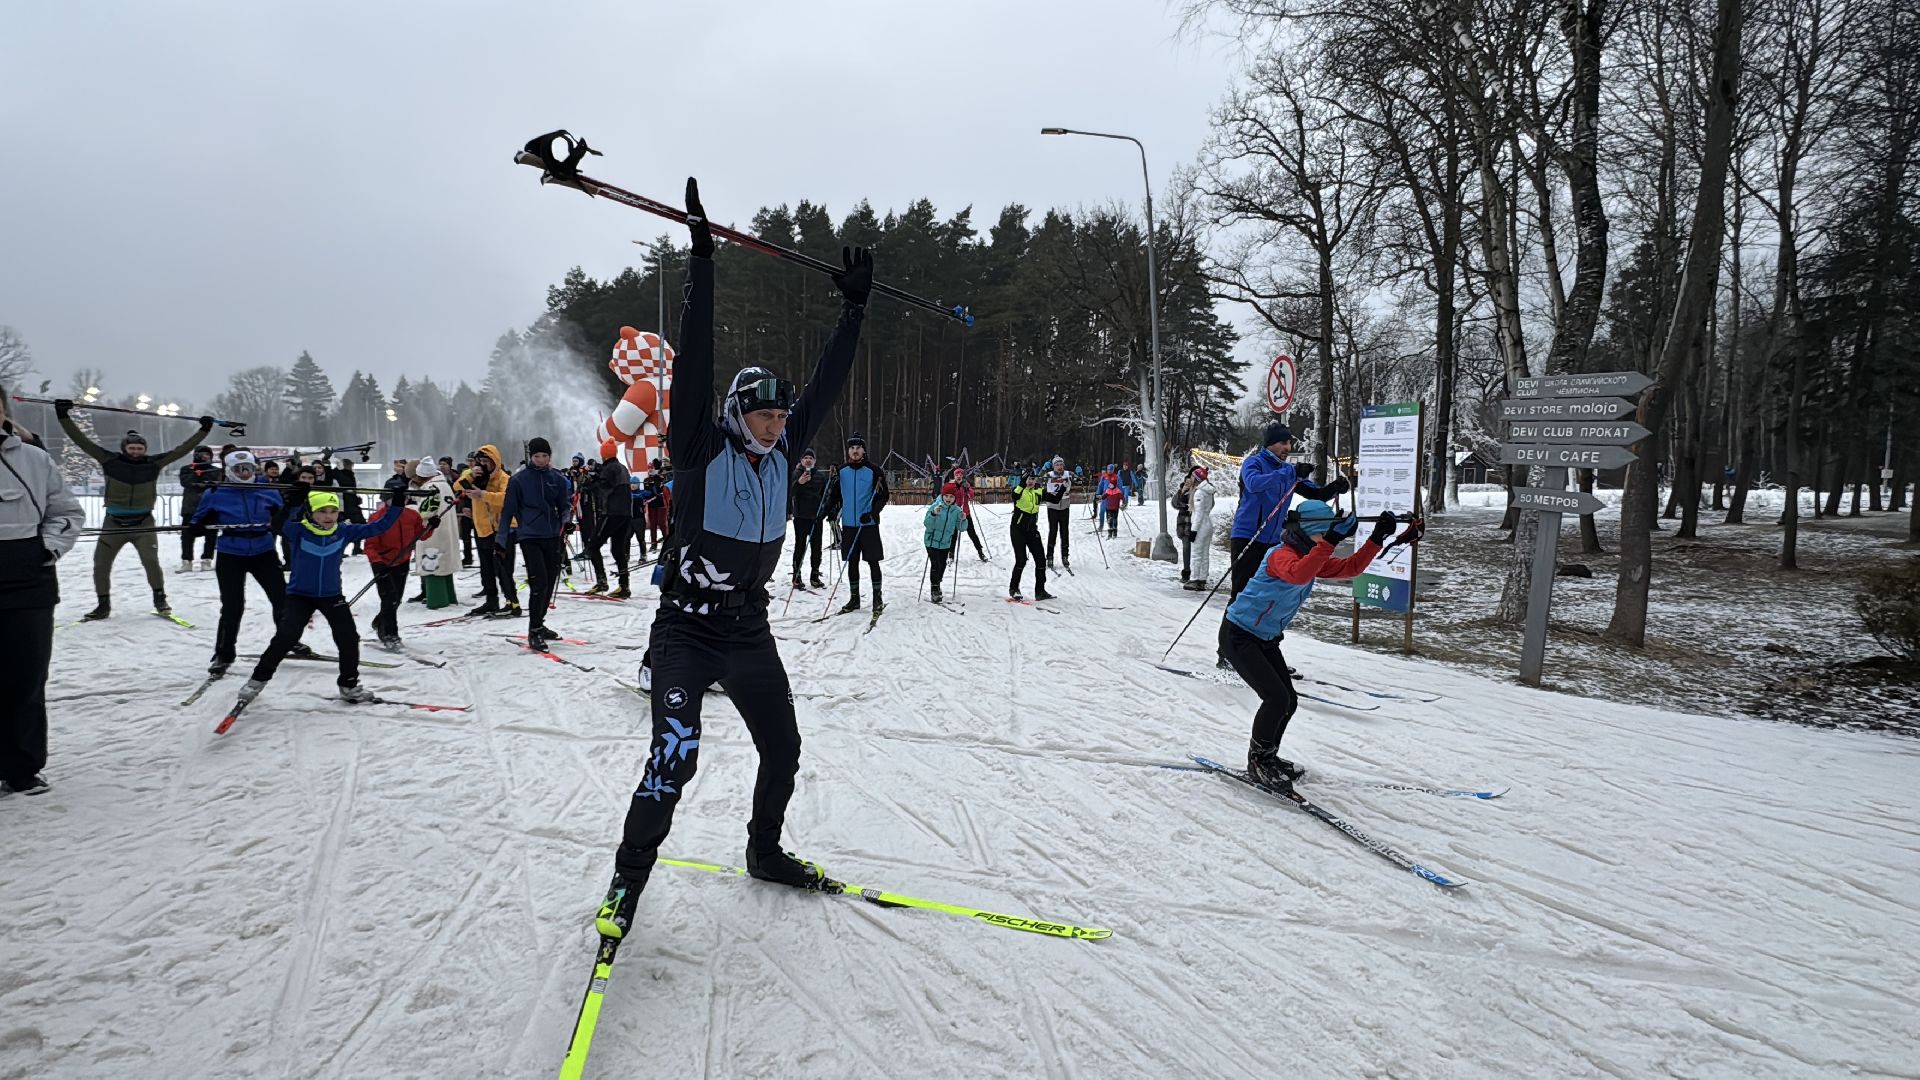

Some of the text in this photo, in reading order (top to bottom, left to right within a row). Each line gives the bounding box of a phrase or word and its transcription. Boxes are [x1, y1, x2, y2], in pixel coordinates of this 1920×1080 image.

[1517, 380, 1539, 389] DEVI
[1544, 379, 1568, 387] ШКОЛА
[1516, 389, 1538, 397] CLUB
[1556, 387, 1600, 395] ЧЕМПИОНА
[1504, 402, 1618, 416] DEVI STORE maloja
[1512, 427, 1630, 438] DEVI CLUB ПРОКАТ
[1517, 449, 1600, 463] DEVI CAFE
[1520, 494, 1579, 508] 50 МЕТРОВ
[974, 912, 1066, 933] FISCHER
